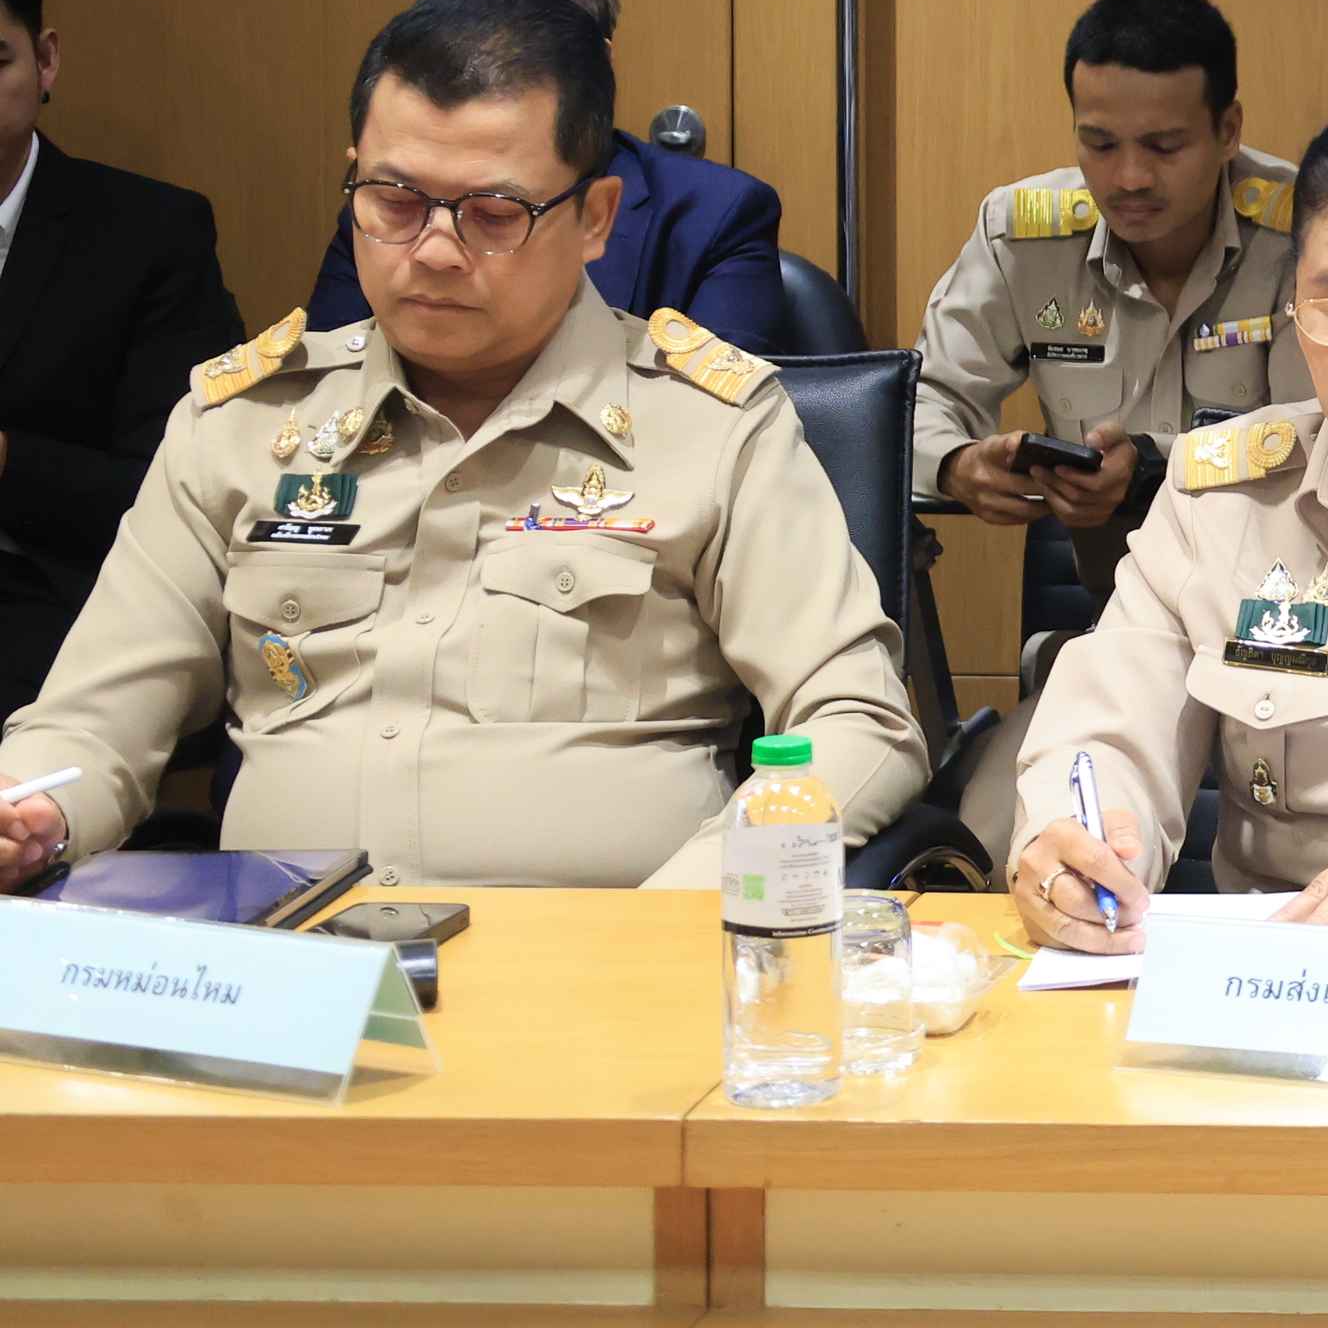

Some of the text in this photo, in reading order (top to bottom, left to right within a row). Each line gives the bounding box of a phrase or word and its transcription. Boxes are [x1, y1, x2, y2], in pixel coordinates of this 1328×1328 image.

[60, 960, 244, 1006] กรมหม่อนไหม
